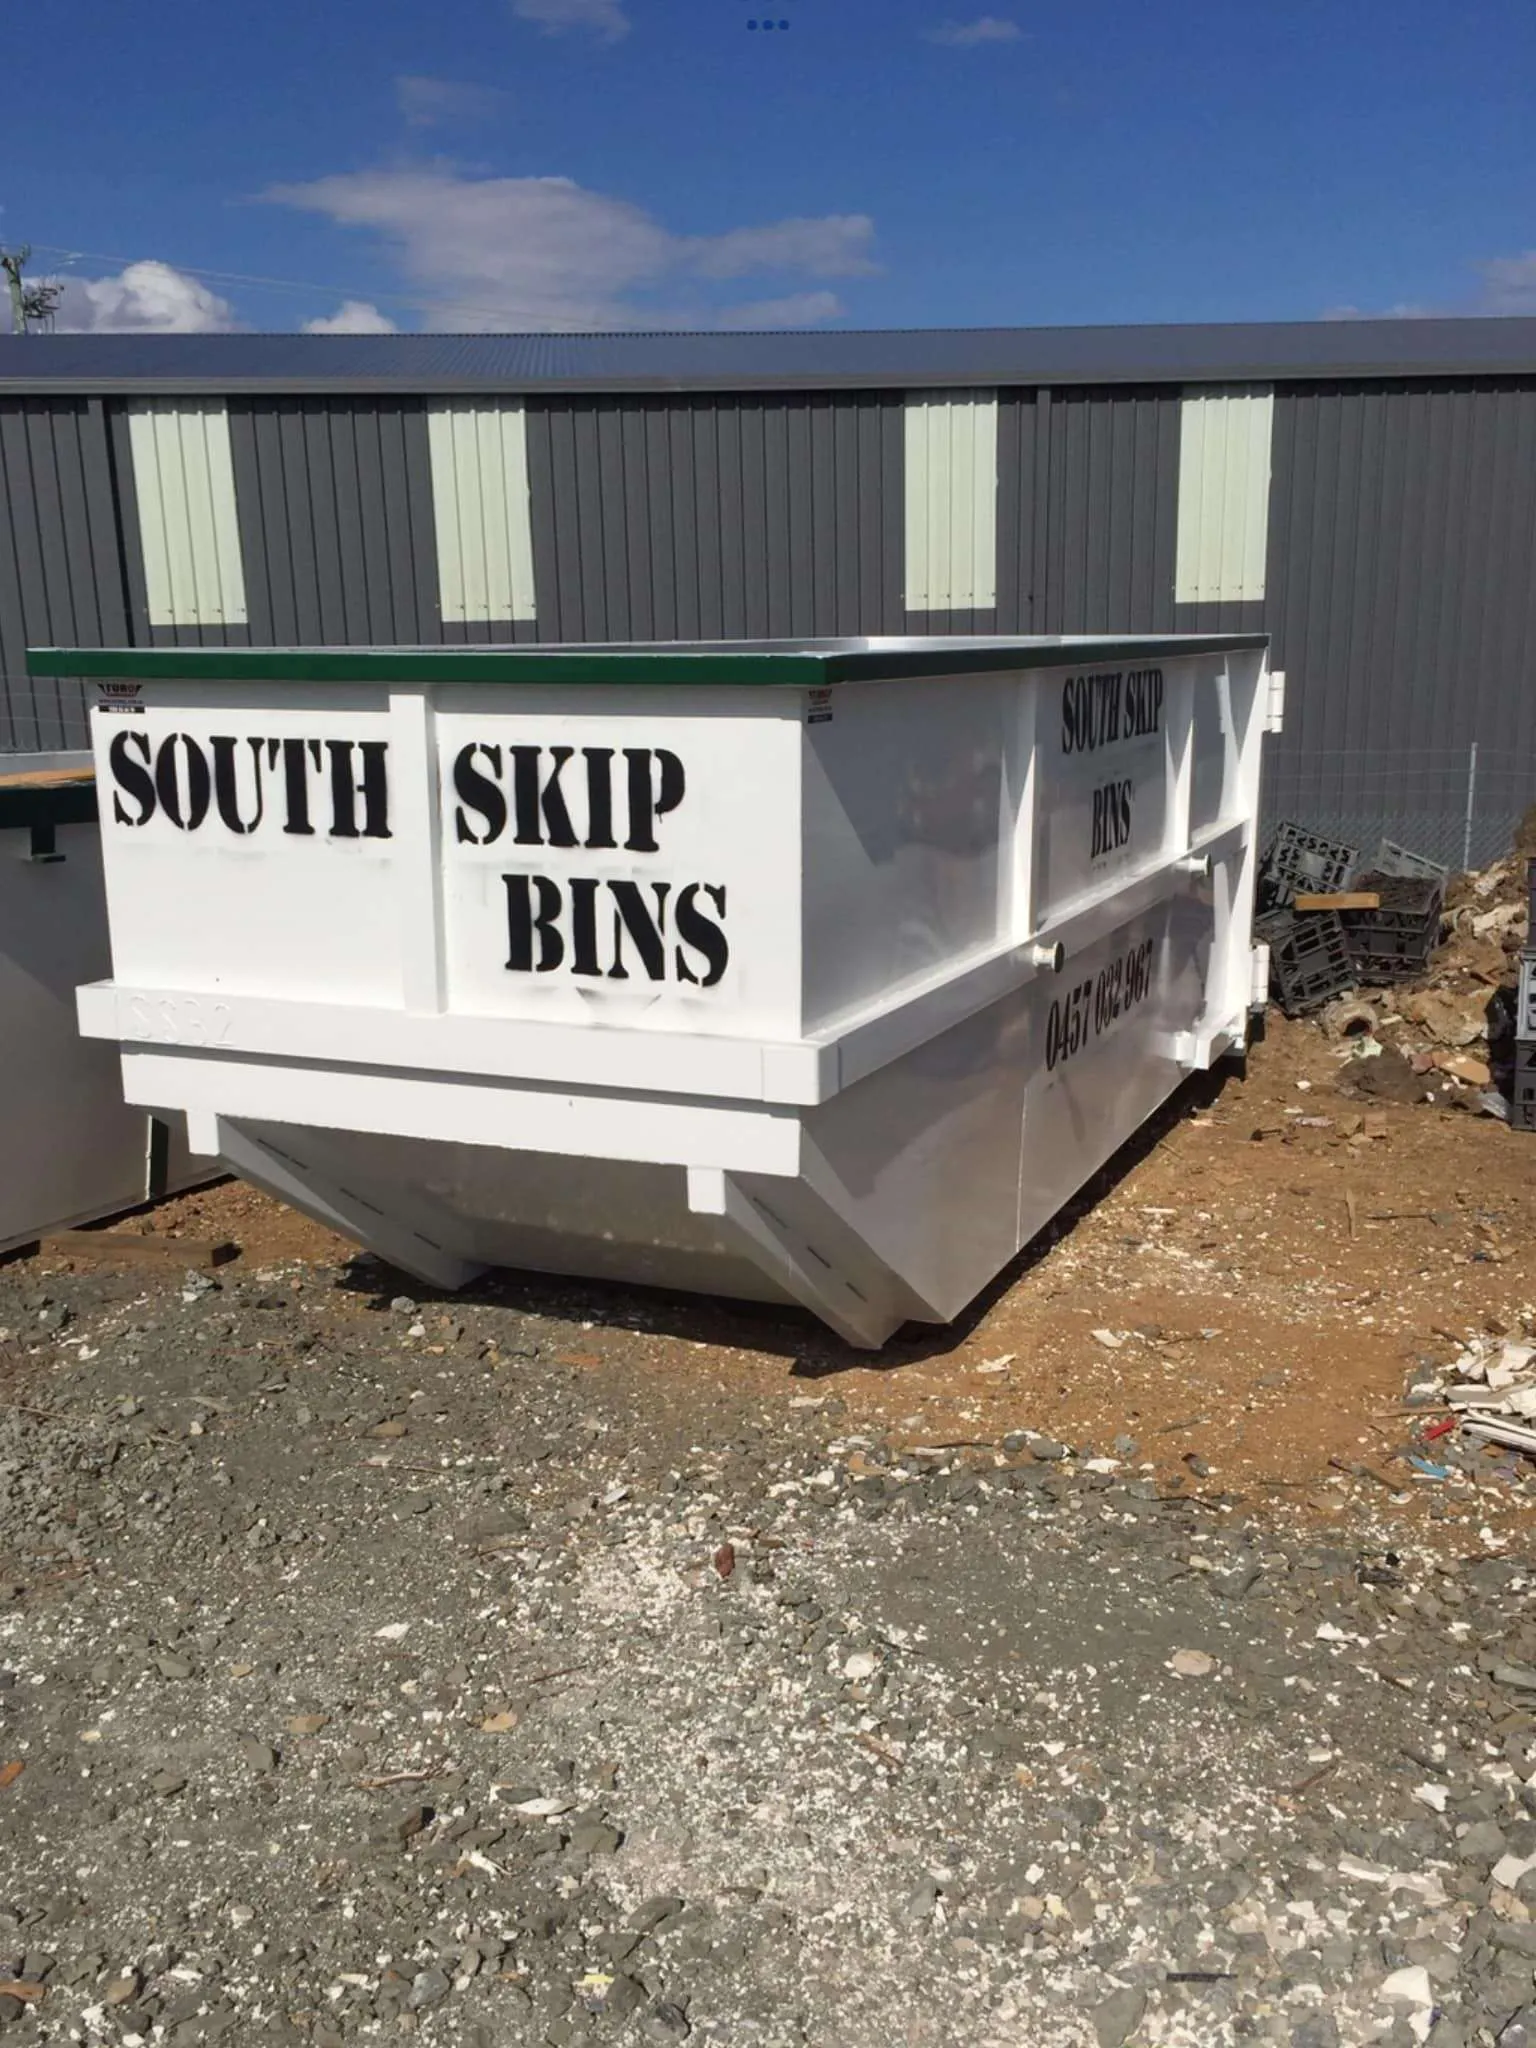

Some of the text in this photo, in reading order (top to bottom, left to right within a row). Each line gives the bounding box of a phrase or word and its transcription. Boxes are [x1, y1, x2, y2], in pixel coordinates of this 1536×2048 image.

[1062, 668, 1163, 755] SOUTH SKIP
[110, 730, 686, 852] SOUTH SKIP
[1091, 779, 1132, 858] BINS
[501, 874, 729, 987] BINS
[1046, 980, 1092, 1071] 0457
[1124, 938, 1153, 1011] 967
